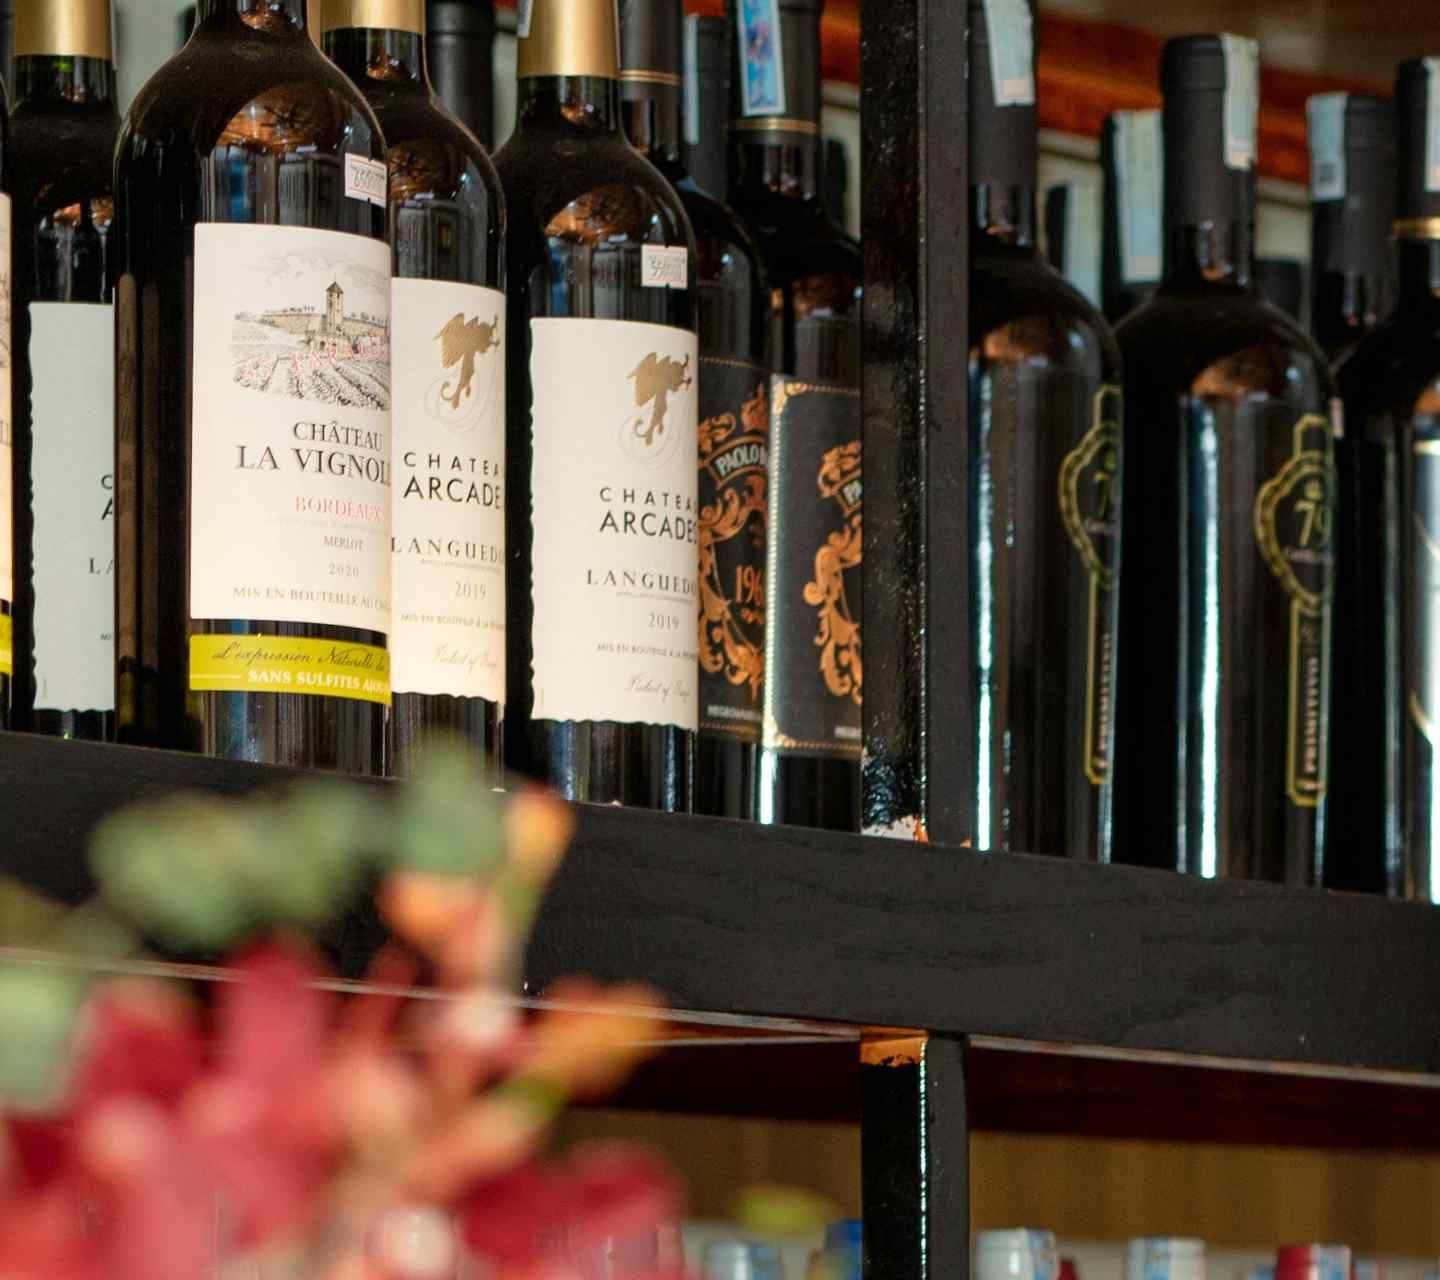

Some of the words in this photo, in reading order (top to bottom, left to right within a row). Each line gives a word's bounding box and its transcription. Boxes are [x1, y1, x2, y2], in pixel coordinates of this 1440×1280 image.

[293, 420, 383, 451] CHÂTEAU
[235, 445, 280, 470] LA
[296, 496, 383, 521] BORDEAUX
[323, 535, 364, 551] MERLOT
[328, 562, 359, 578] 2020
[455, 581, 487, 600] 2019
[648, 613, 680, 630] 2019
[248, 671, 291, 684] SANS
[297, 671, 360, 691] SULFITES
